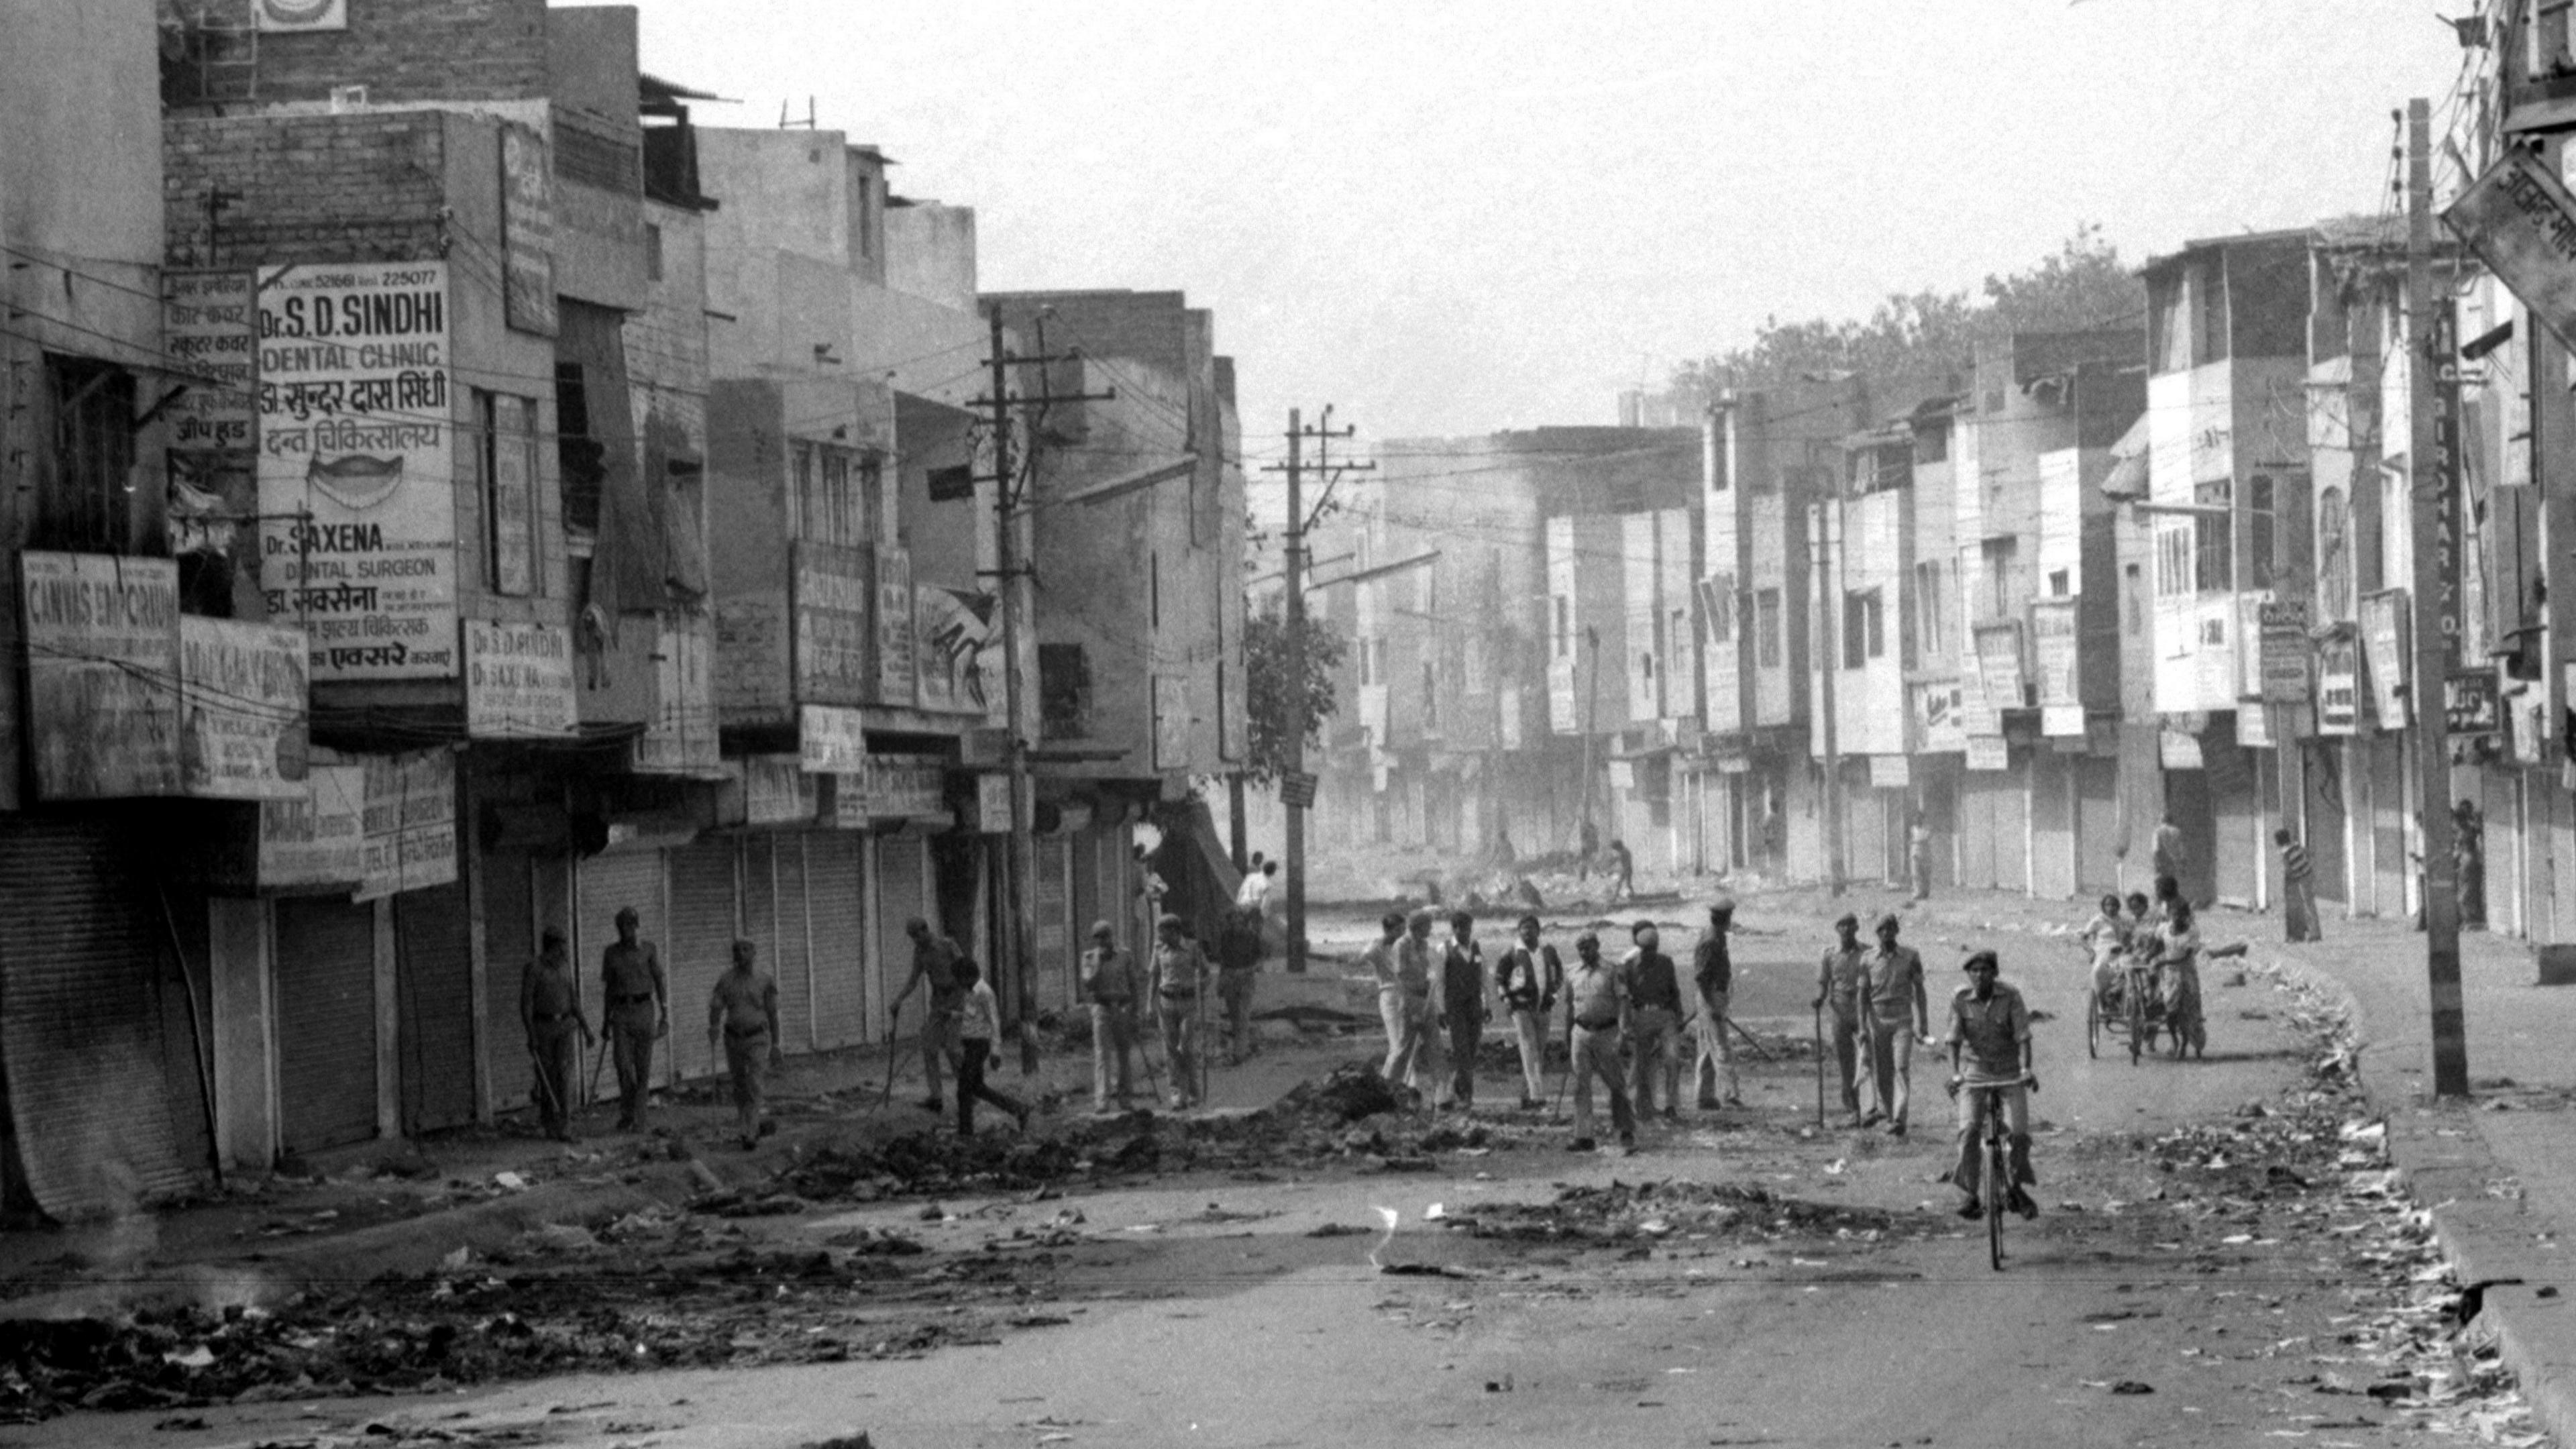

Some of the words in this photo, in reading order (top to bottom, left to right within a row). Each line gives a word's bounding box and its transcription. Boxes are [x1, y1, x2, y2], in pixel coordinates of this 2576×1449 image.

[382, 270, 436, 286] 225077
[215, 335, 249, 354] कवर
[263, 345, 353, 372] DENTAL
[360, 341, 440, 369] CLINIC
[285, 380, 344, 421] सुन्दर
[350, 378, 394, 413] दास
[397, 370, 446, 409] सिंधी
[266, 427, 309, 456] दन्त
[313, 419, 441, 452] चिकित्सालय
[266, 535, 288, 555] Dr.
[290, 523, 383, 553] SAXENA
[285, 561, 352, 581] DNTAL
[358, 557, 436, 578] SURGEON
[266, 589, 289, 614] डा.
[292, 582, 378, 613] सक्सेना
[321, 619, 360, 640] शल्य
[363, 614, 429, 638] चिकित्सक
[329, 641, 409, 670] एक्सरे
